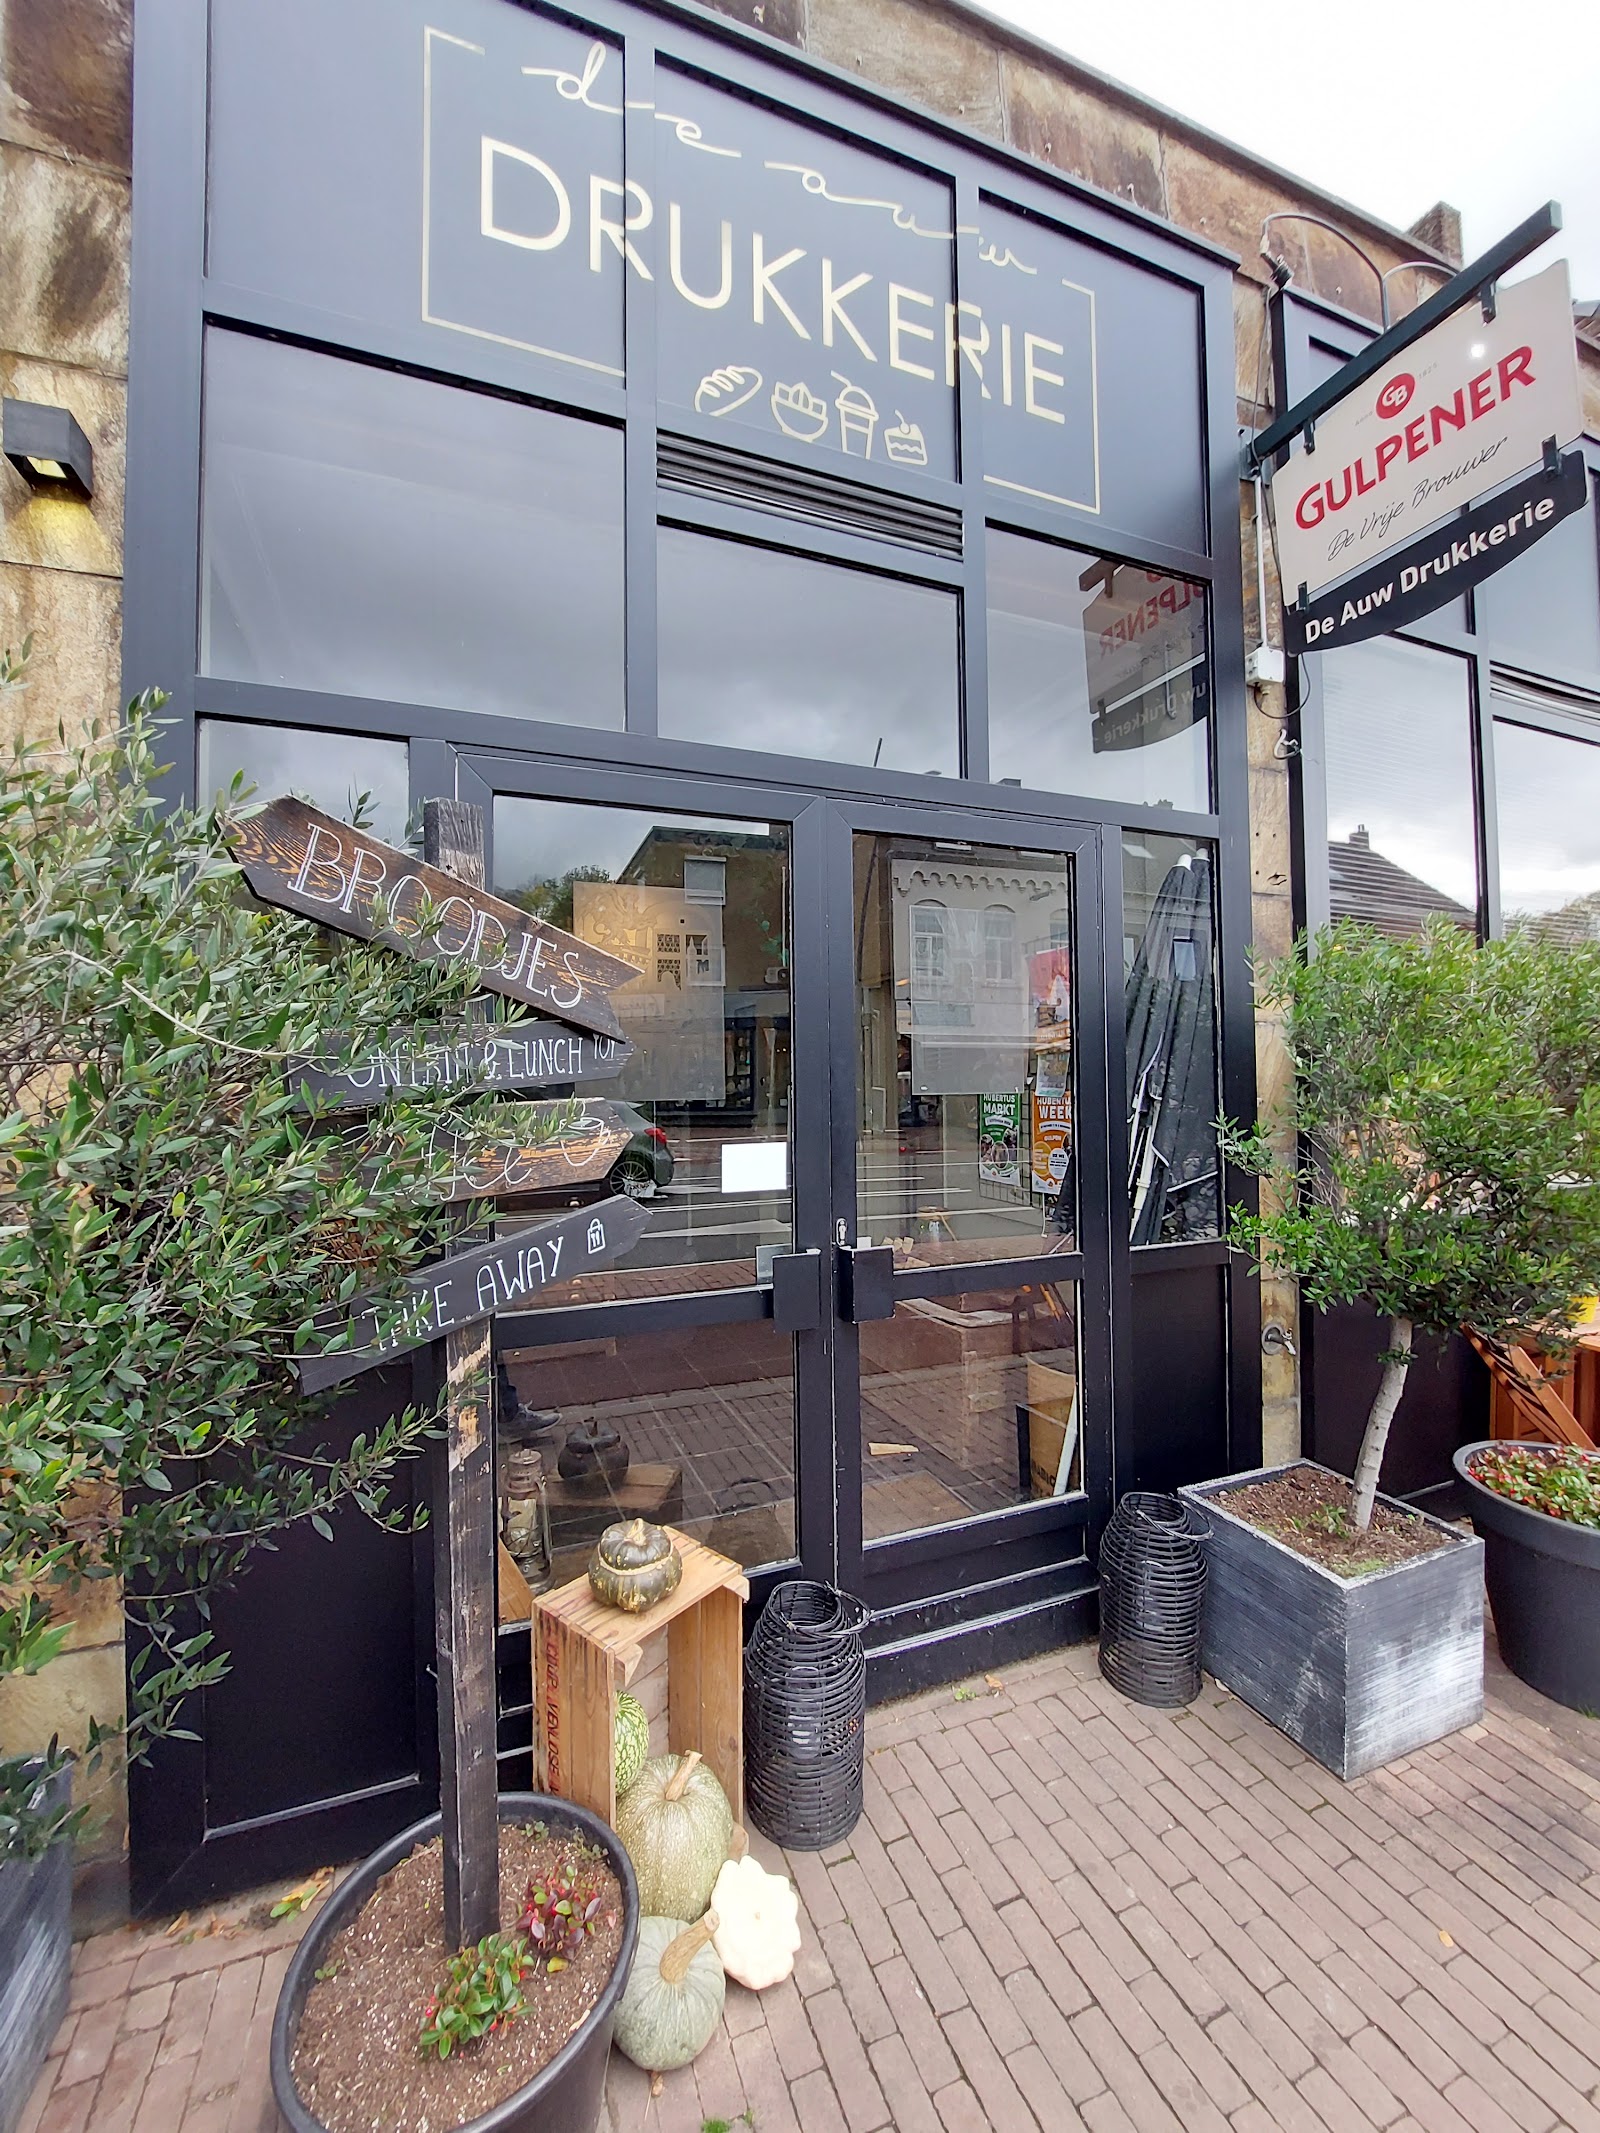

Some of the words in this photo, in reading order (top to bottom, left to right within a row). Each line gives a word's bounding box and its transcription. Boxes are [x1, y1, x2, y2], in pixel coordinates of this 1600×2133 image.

[521, 41, 742, 157] de
[480, 134, 1066, 425] DRUKKERIE
[1294, 345, 1537, 531] GULPENER
[1327, 528, 1356, 562] De
[1358, 500, 1405, 539] Vrije
[1411, 435, 1509, 509] Brouwer
[1304, 616, 1335, 645] De
[1339, 582, 1395, 627] Auw
[1399, 497, 1556, 594] Drukkerie
[287, 823, 585, 1009] BROODJES
[507, 1036, 584, 1080] LUNCH
[983, 1102, 1016, 1116] MARKT
[1036, 1096, 1072, 1105] HUBERTU
[1038, 1105, 1072, 1120] WEEK
[476, 1234, 565, 1313] AWAY
